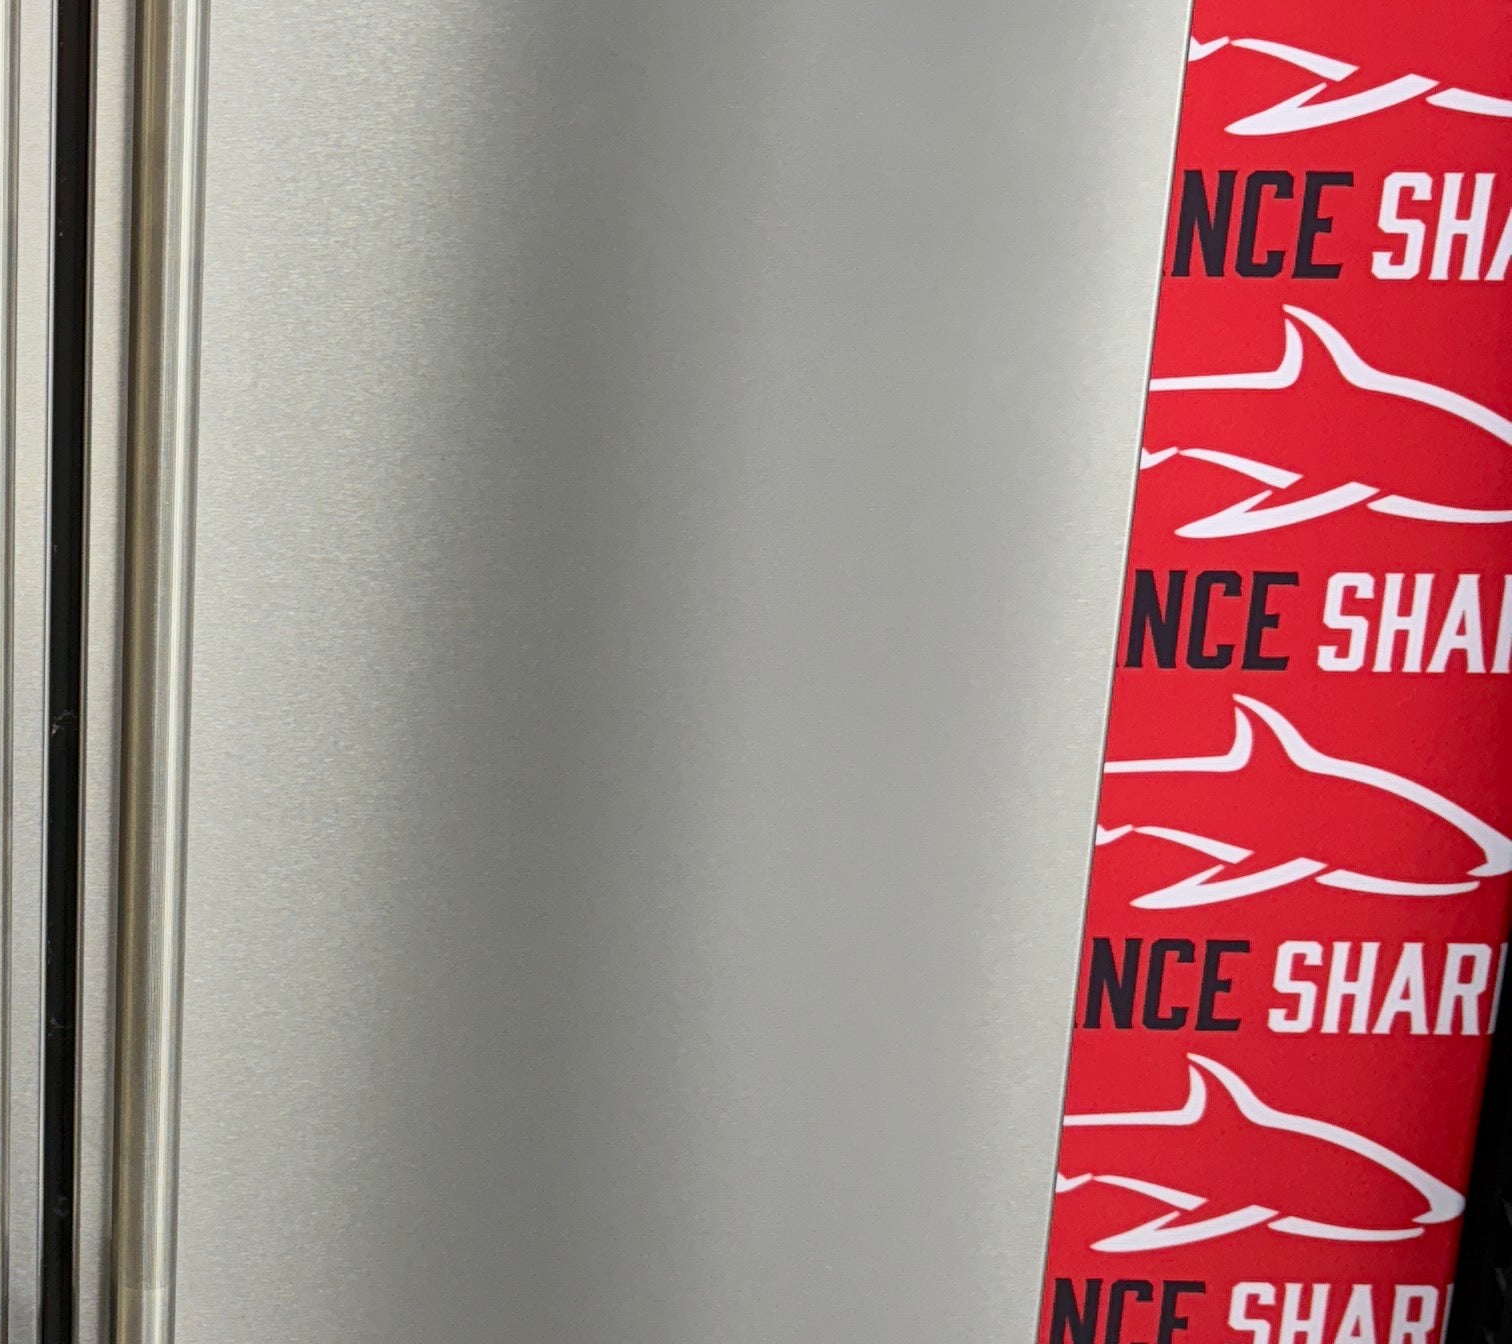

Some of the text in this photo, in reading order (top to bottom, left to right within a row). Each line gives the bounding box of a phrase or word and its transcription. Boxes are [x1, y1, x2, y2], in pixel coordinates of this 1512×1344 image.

[1163, 170, 1354, 279] NCE
[1116, 569, 1512, 675] NCE SHA
[1074, 937, 1508, 1036] NCE SHAR
